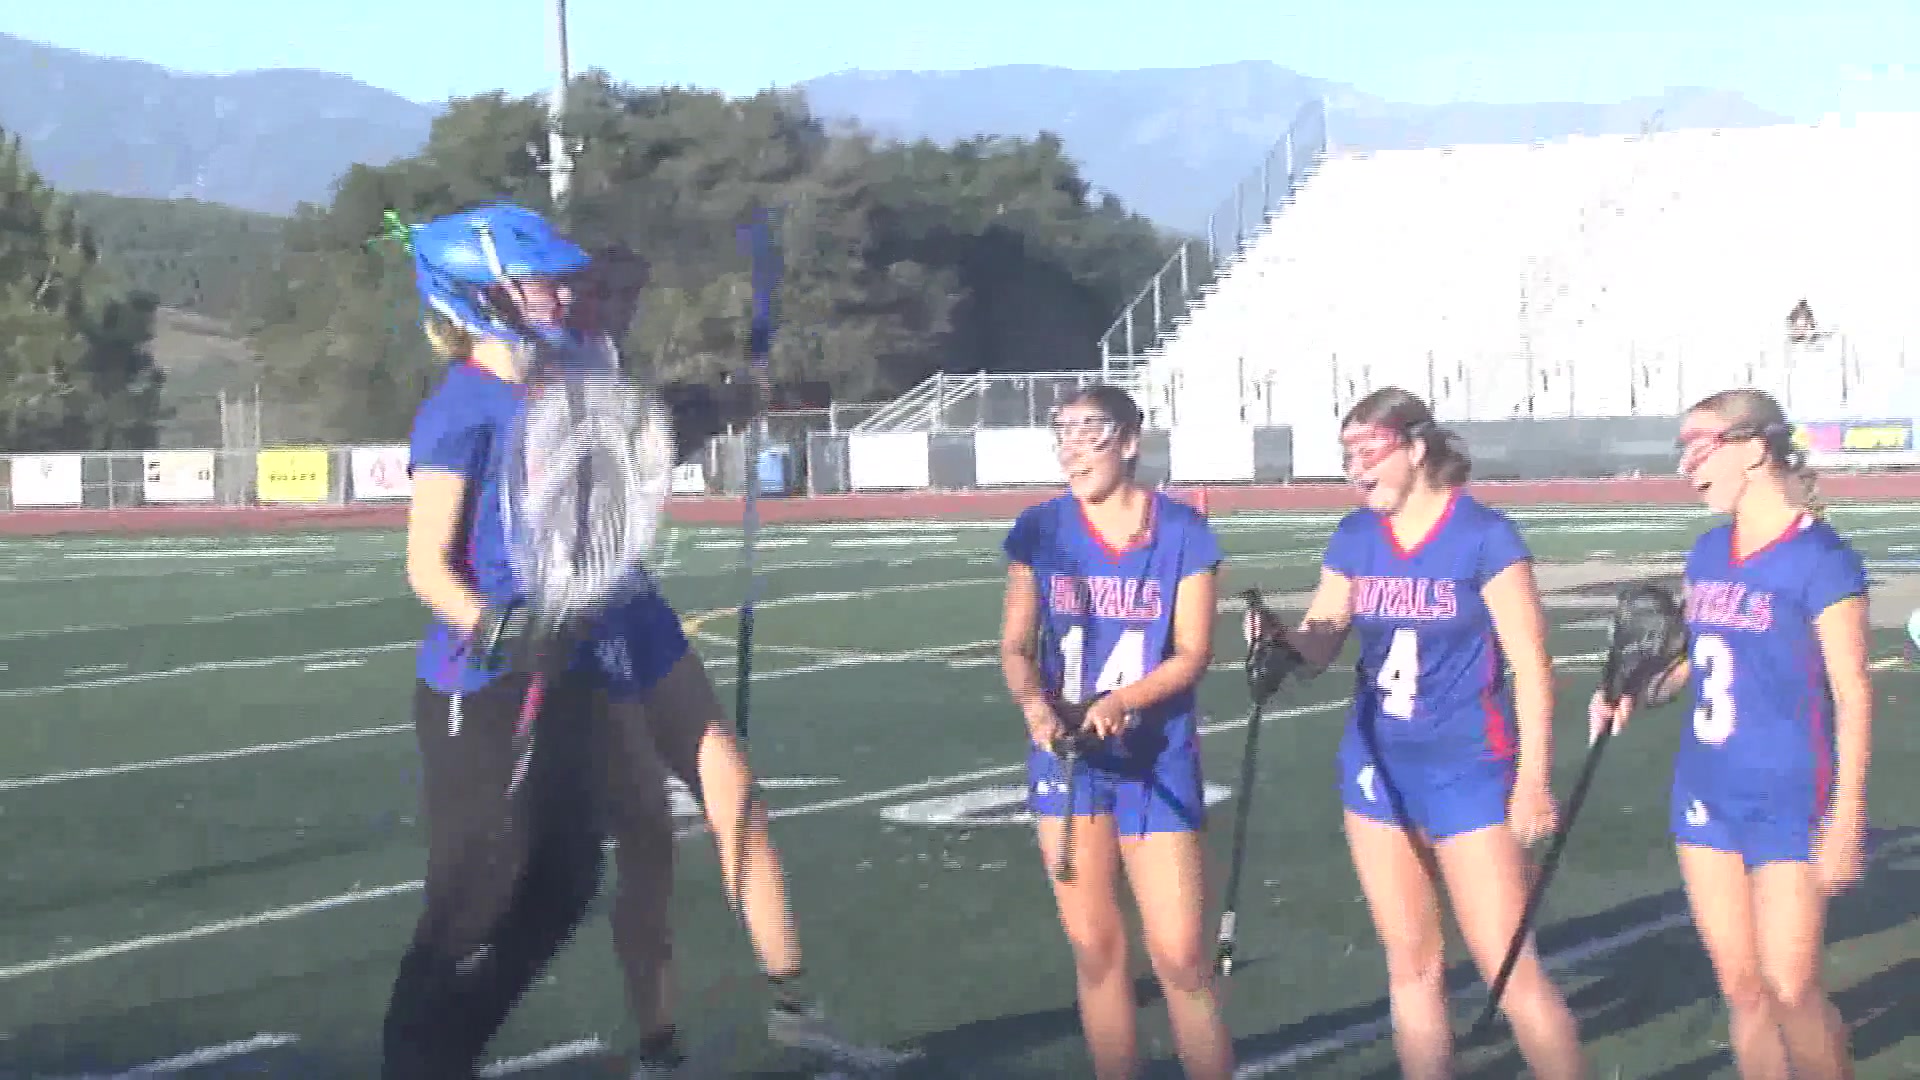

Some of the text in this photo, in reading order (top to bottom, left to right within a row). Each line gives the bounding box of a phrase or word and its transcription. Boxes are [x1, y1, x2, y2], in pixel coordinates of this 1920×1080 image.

[1060, 626, 1145, 704] 14
[1376, 628, 1419, 720] 4
[1693, 634, 1736, 744] 3
